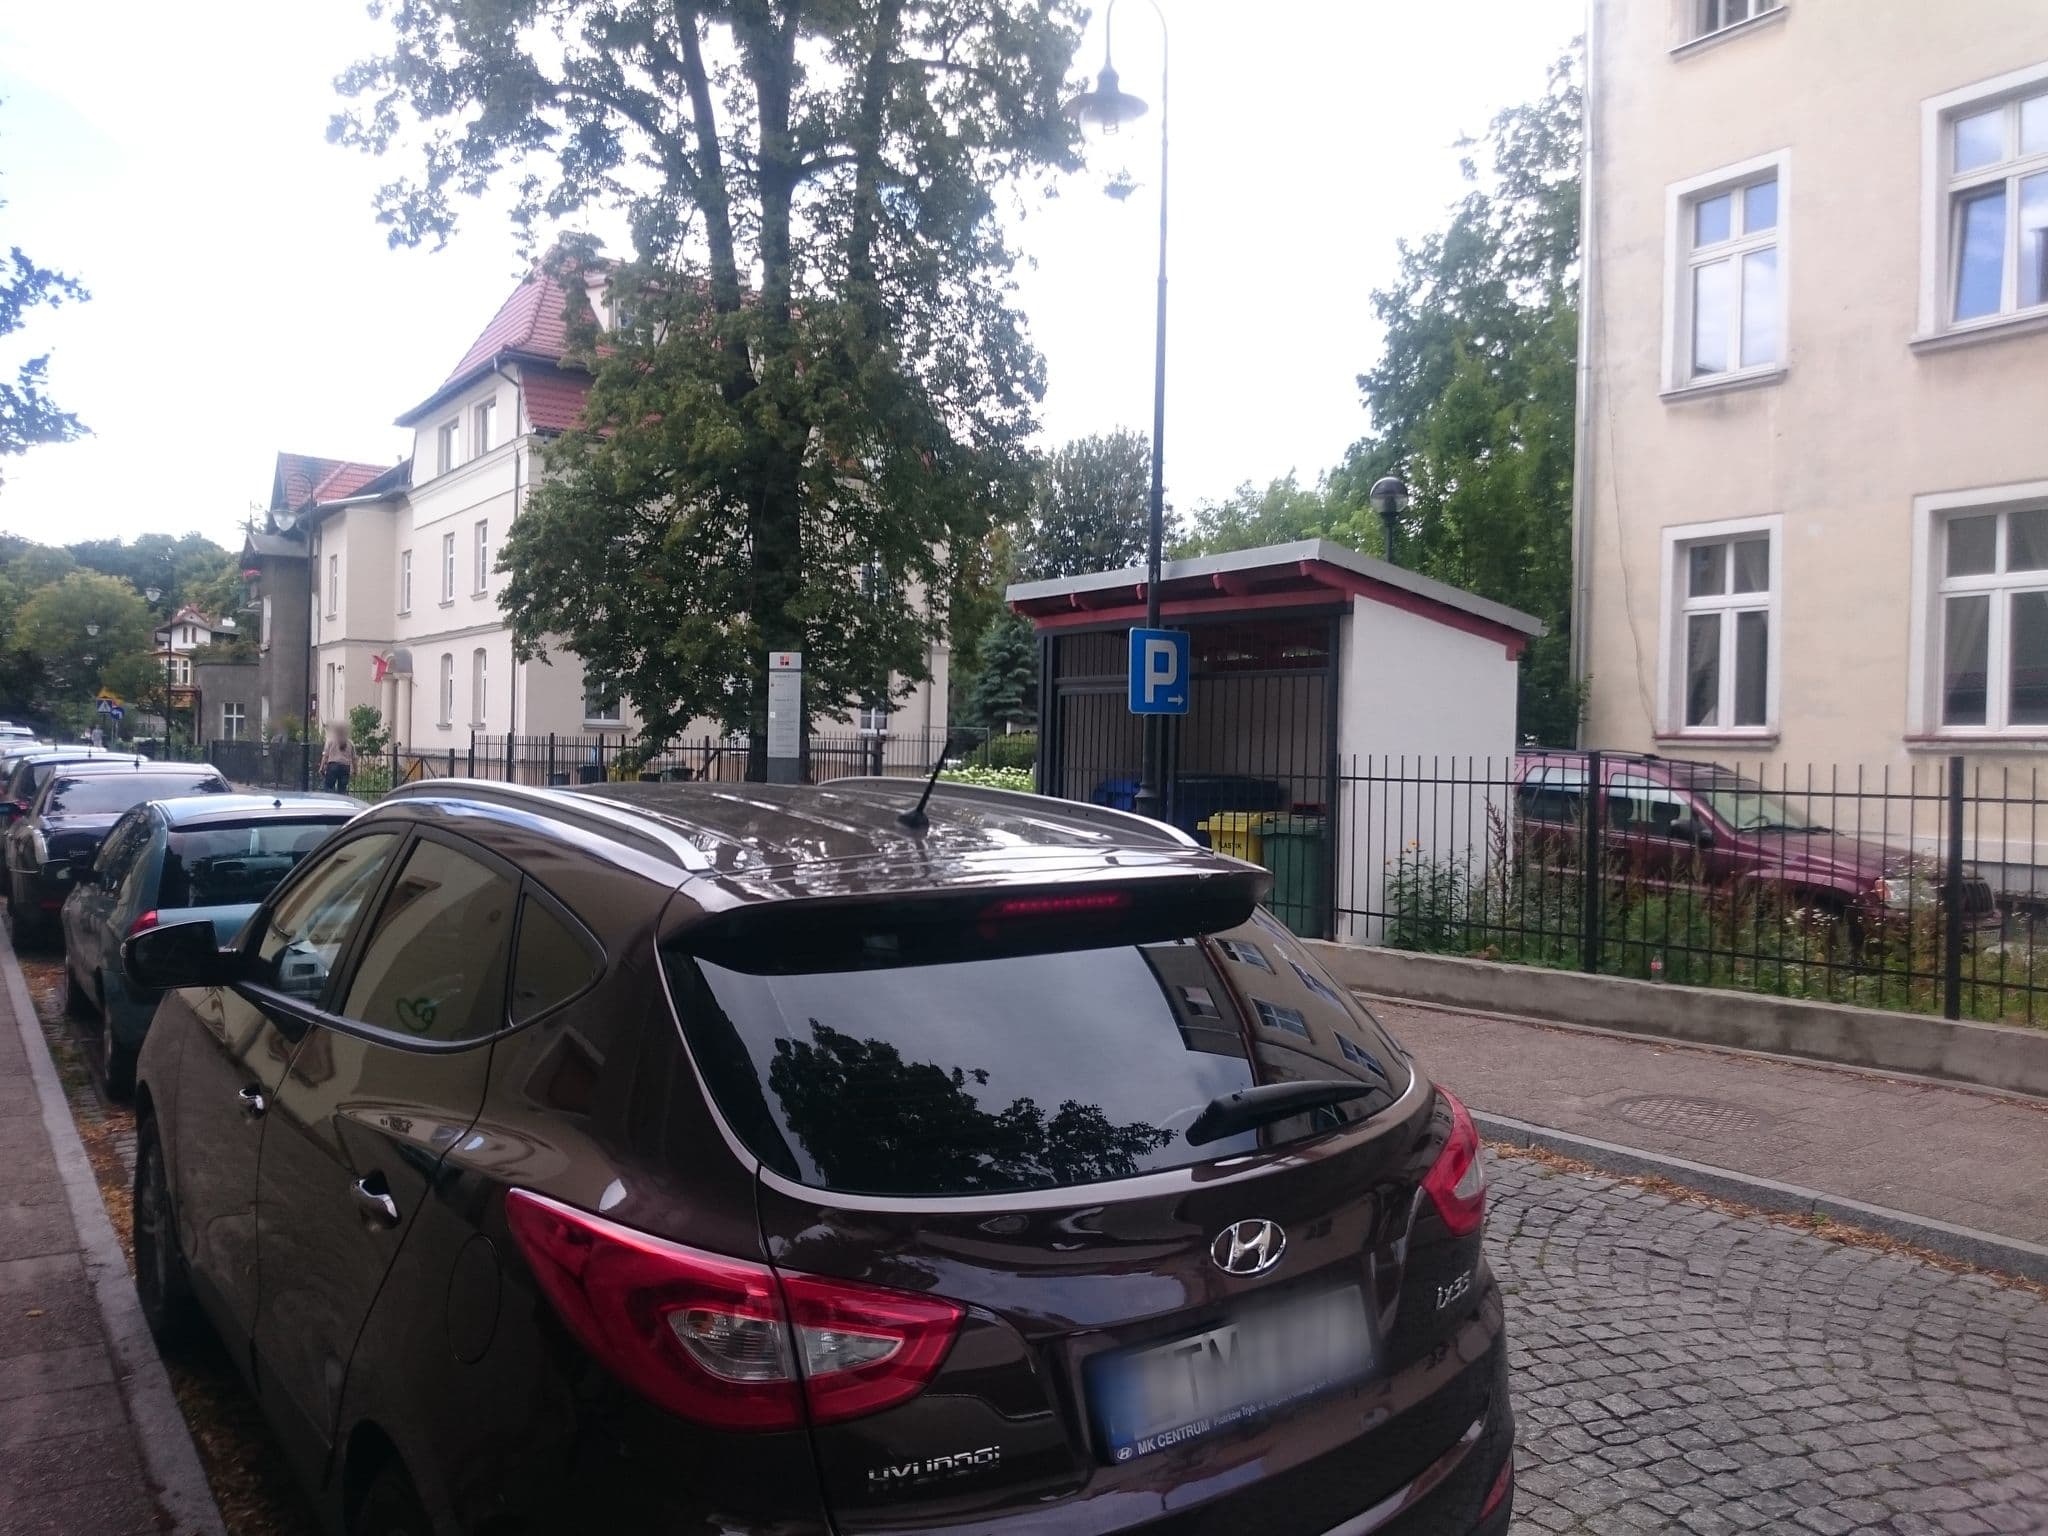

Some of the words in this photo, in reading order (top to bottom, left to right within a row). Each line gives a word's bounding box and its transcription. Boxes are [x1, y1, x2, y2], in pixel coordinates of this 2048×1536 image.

[1145, 639, 1178, 703] P
[1436, 1270, 1471, 1310] ix35
[1137, 1438, 1156, 1455] MK
[1157, 1420, 1211, 1447] CENTRUM
